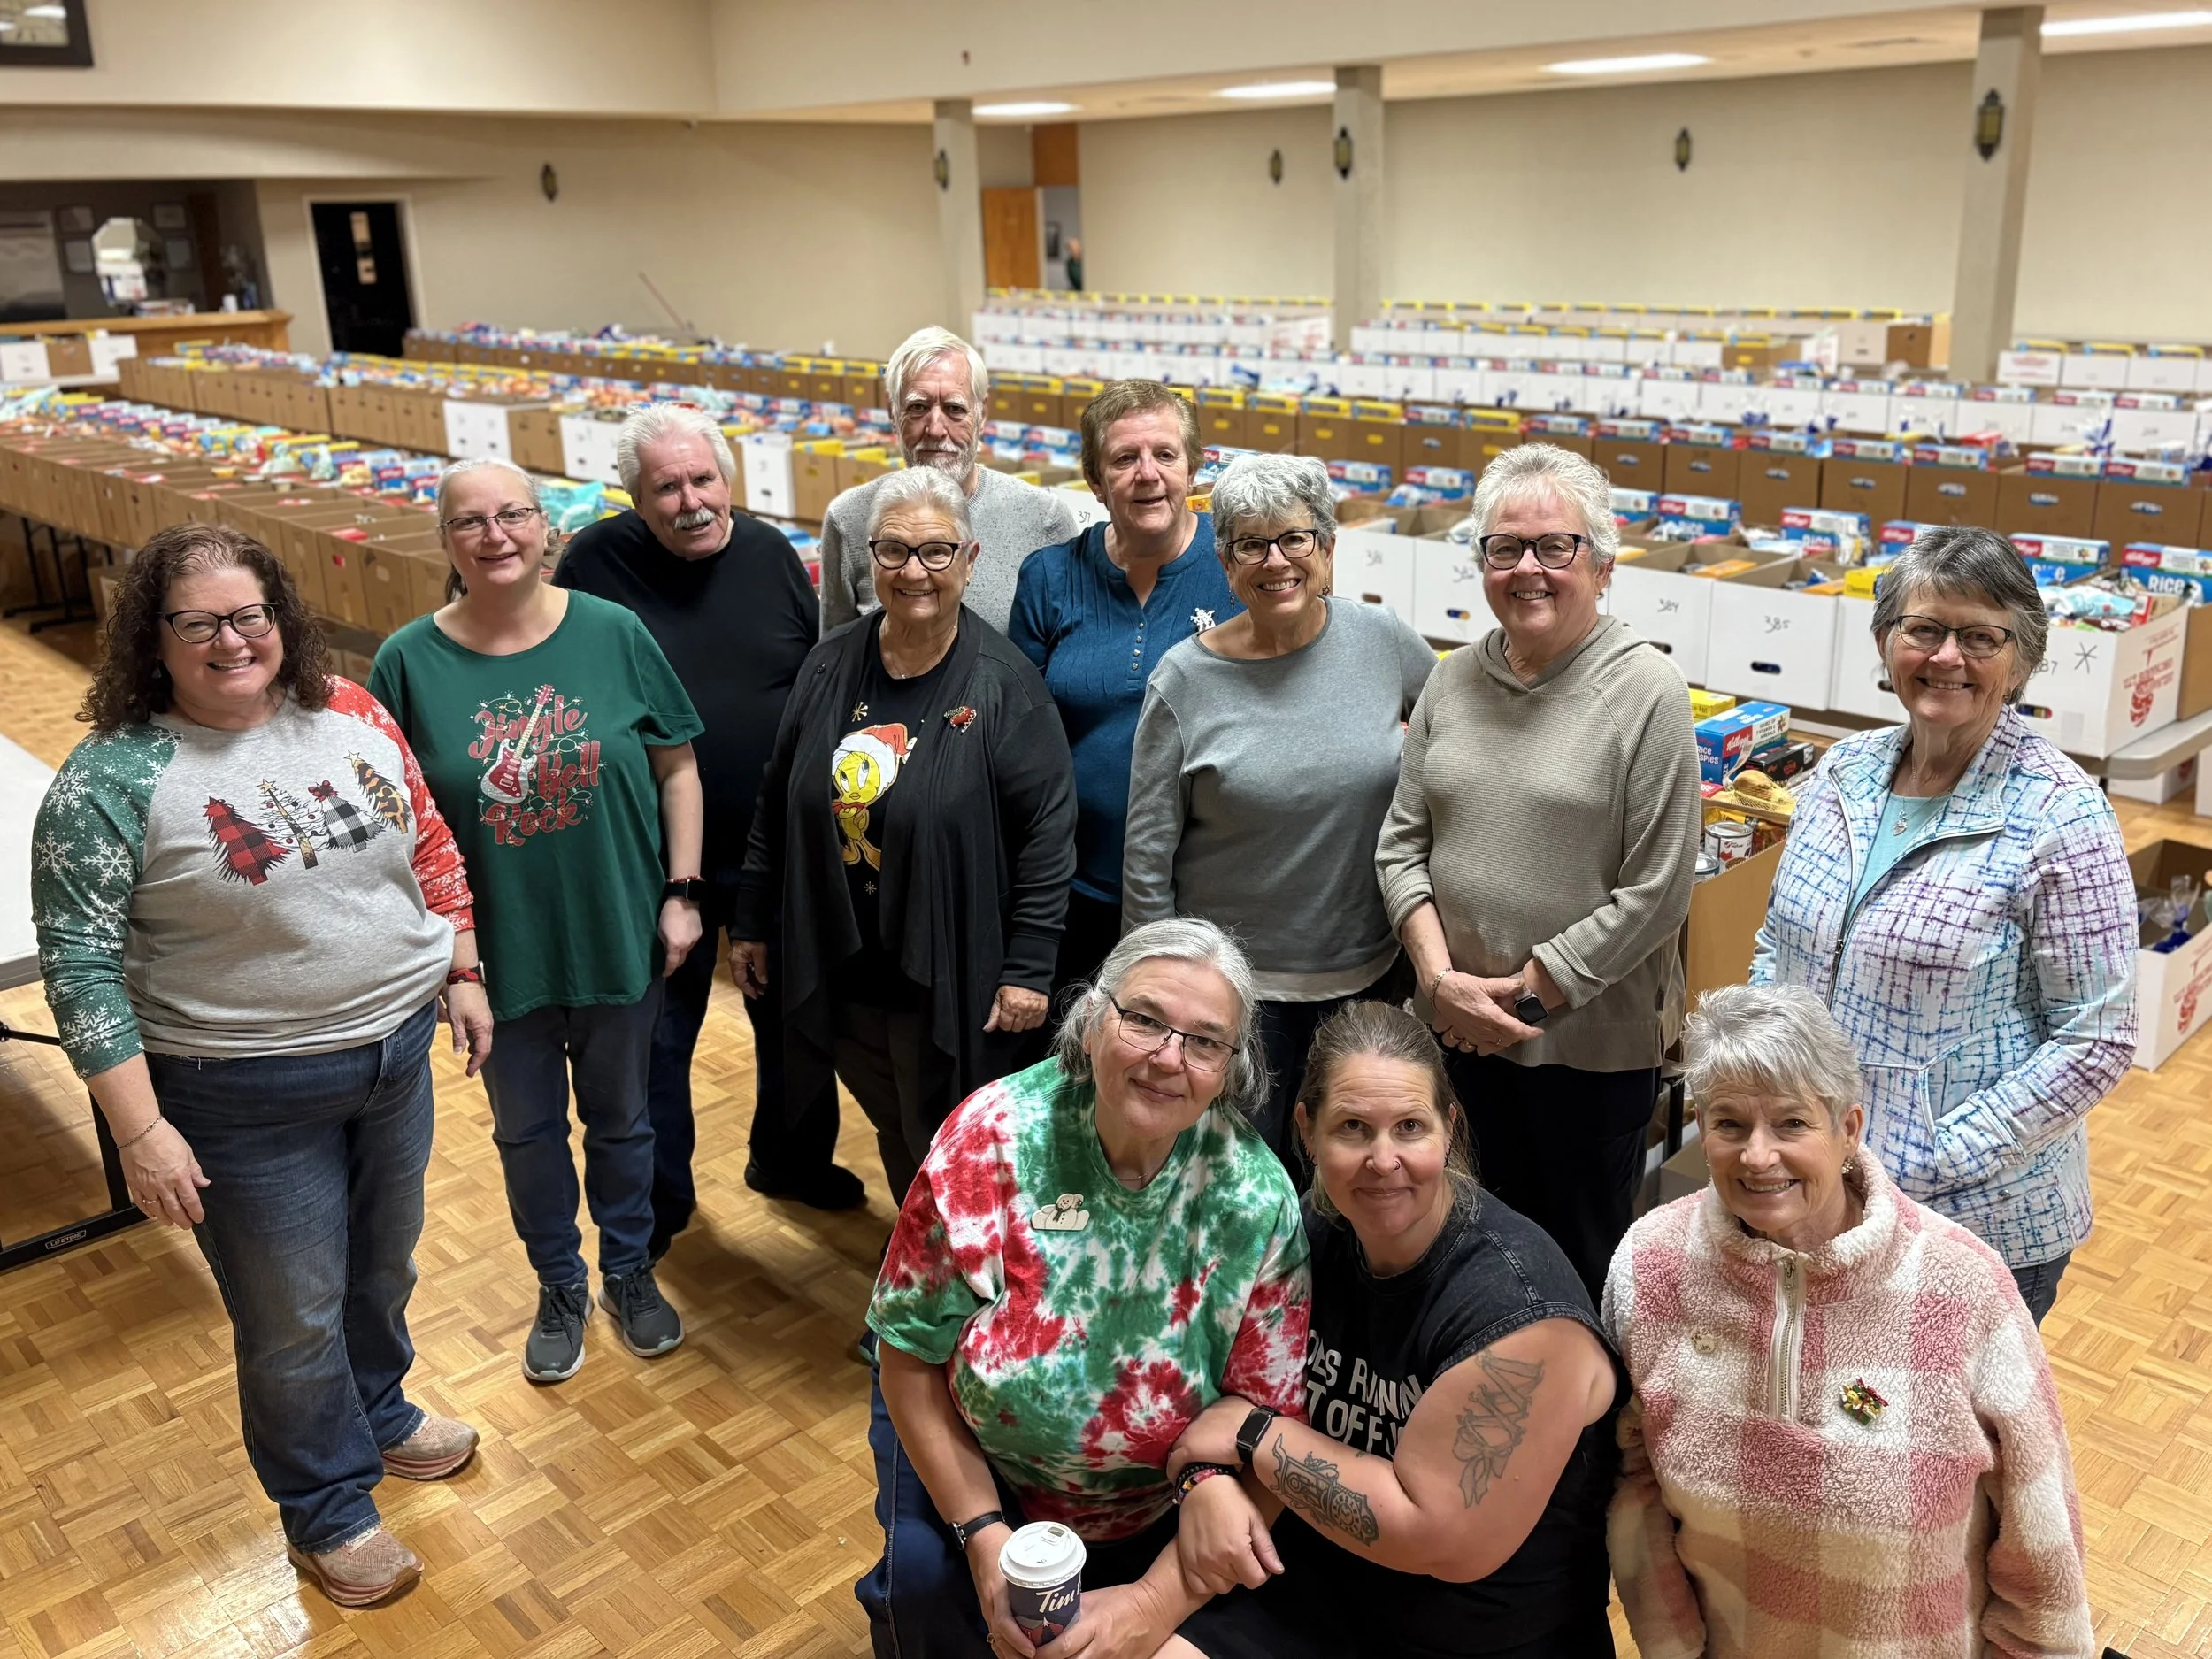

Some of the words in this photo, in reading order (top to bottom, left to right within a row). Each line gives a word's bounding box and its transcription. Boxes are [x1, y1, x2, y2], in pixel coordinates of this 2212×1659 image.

[1763, 615, 1792, 634] 385
[468, 695, 588, 759] Jingle
[529, 741, 601, 800] Bell
[485, 788, 585, 846] Rock
[50, 1233, 81, 1247] LIFETIME
[1035, 1585, 1075, 1614] Tim
